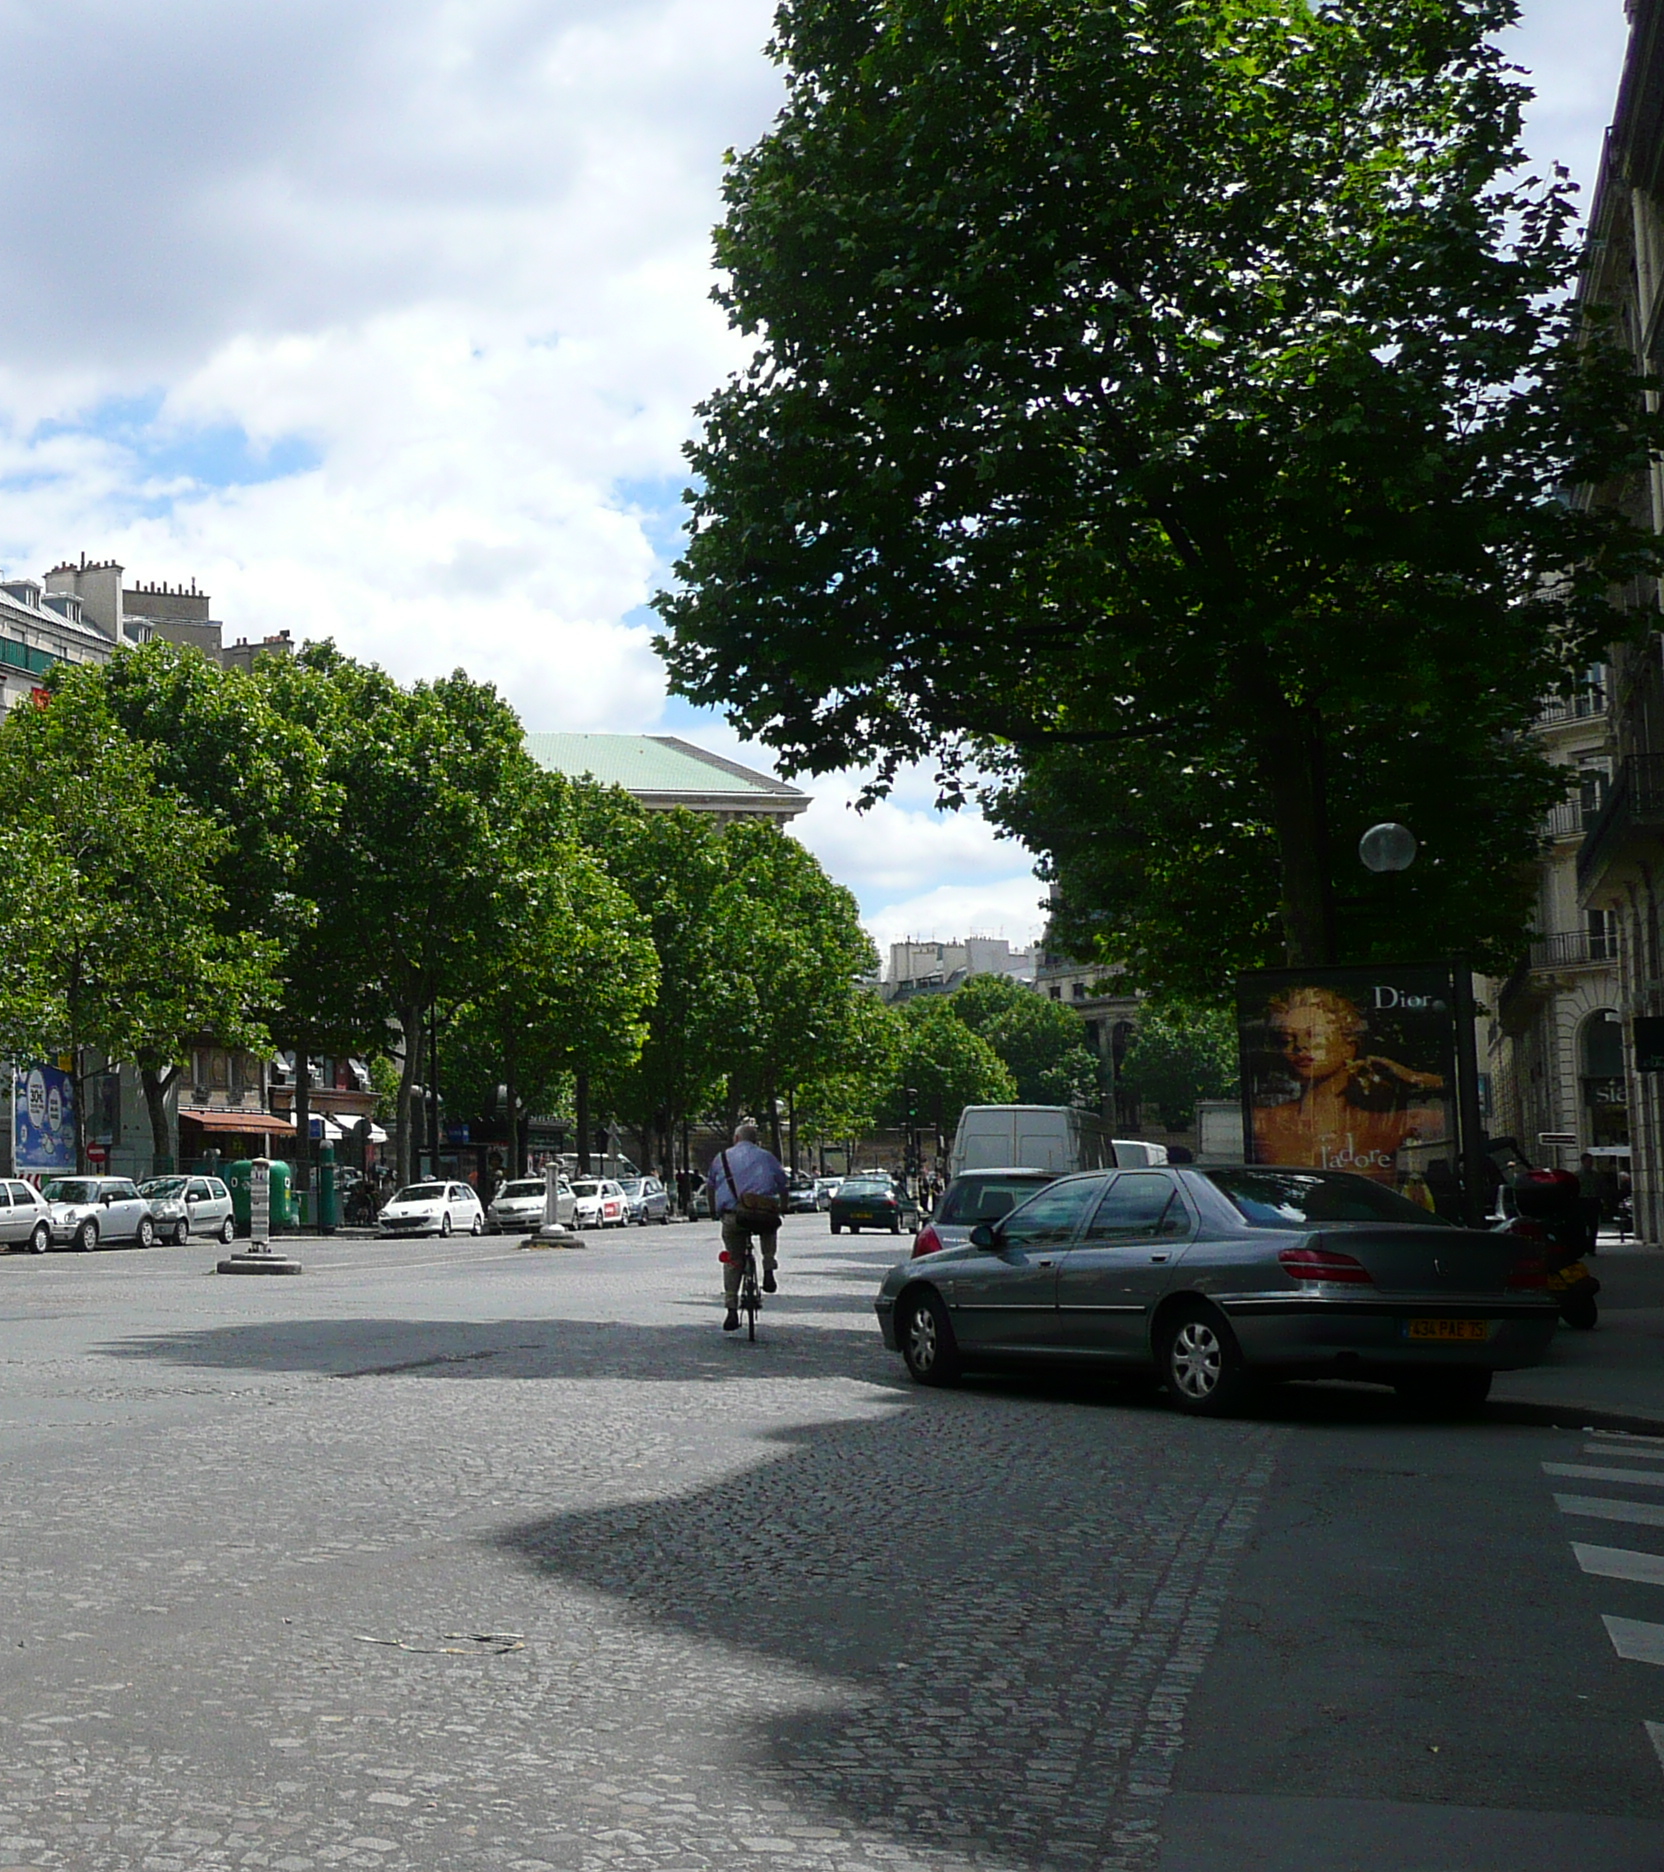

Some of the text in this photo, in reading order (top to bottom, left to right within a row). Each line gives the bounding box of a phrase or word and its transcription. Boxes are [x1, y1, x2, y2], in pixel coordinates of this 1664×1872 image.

[1374, 986, 1431, 1009] Dior
[1413, 1320, 1436, 1336] 434
[1439, 1321, 1465, 1337] PAE
